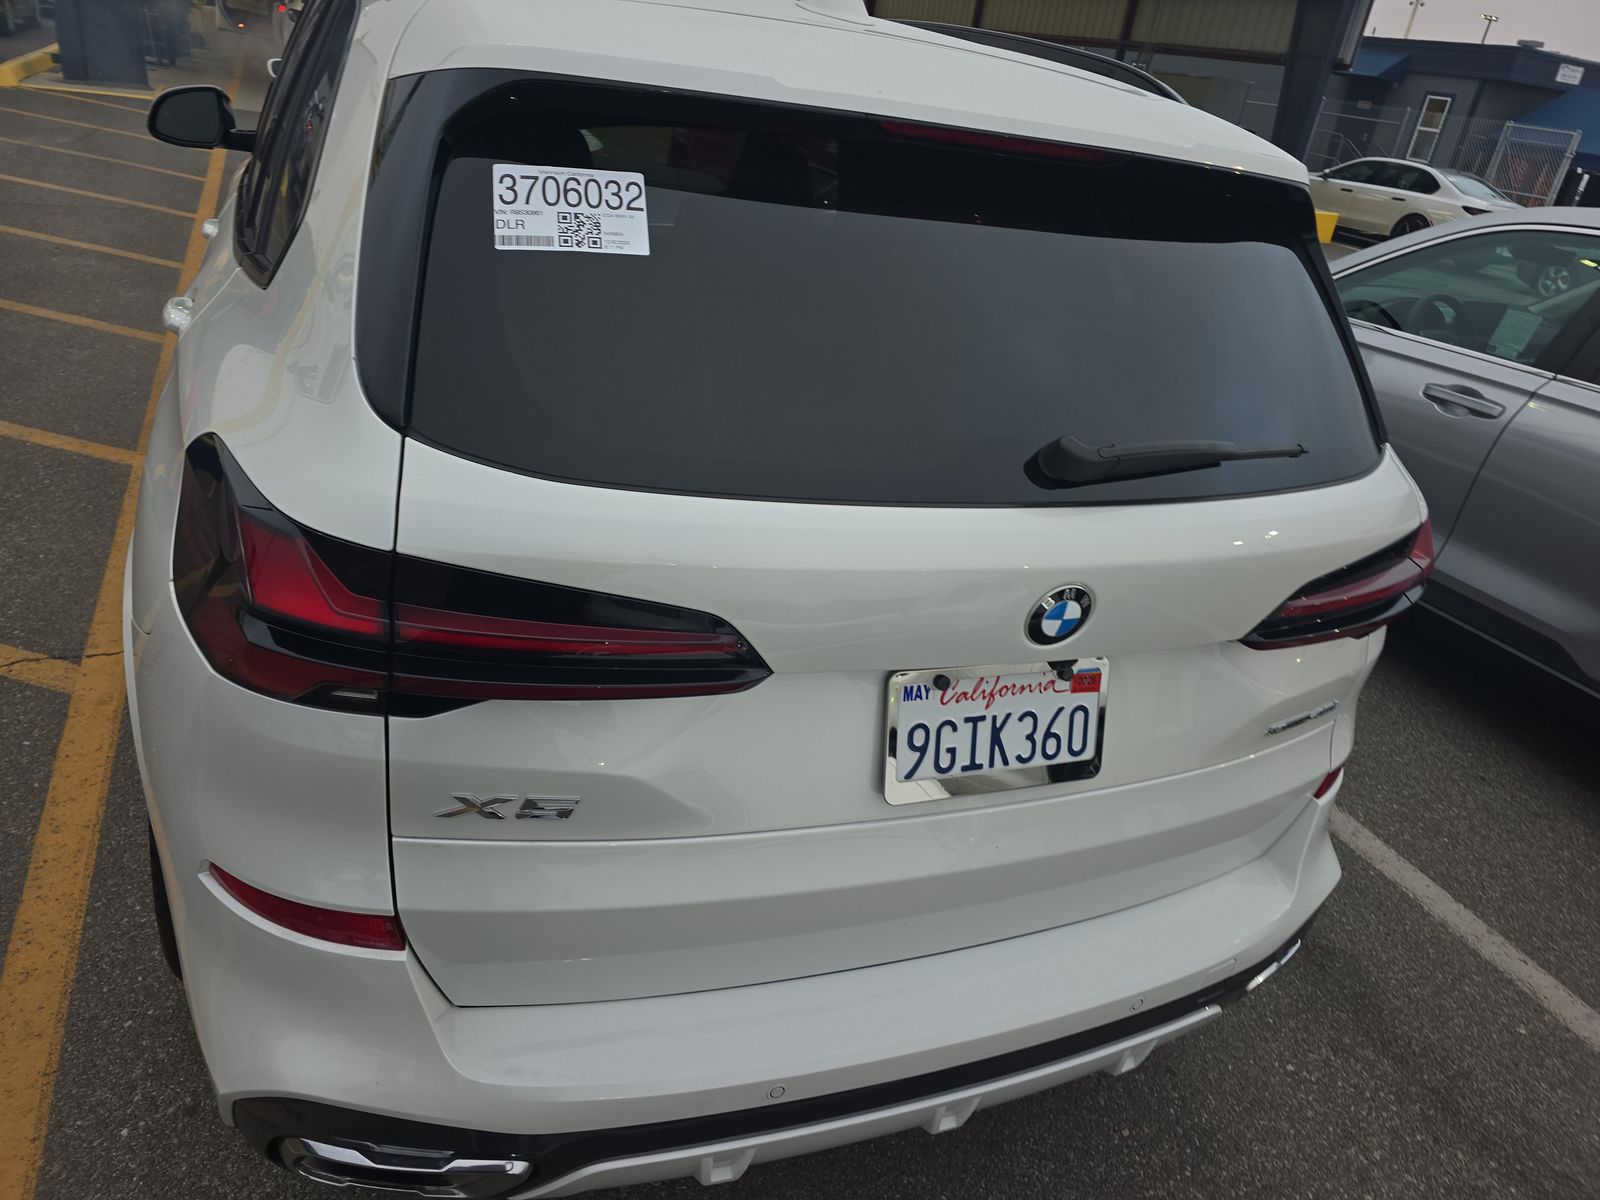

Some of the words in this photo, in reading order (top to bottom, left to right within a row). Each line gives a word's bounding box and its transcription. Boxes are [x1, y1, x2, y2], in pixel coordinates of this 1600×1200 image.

[498, 173, 644, 211] 3706032
[496, 219, 525, 230] DLR
[1041, 588, 1090, 610] BMW
[903, 684, 931, 703] MAY
[939, 672, 1070, 711] California
[904, 704, 1090, 780] 9GIK360
[433, 792, 582, 820] X5
